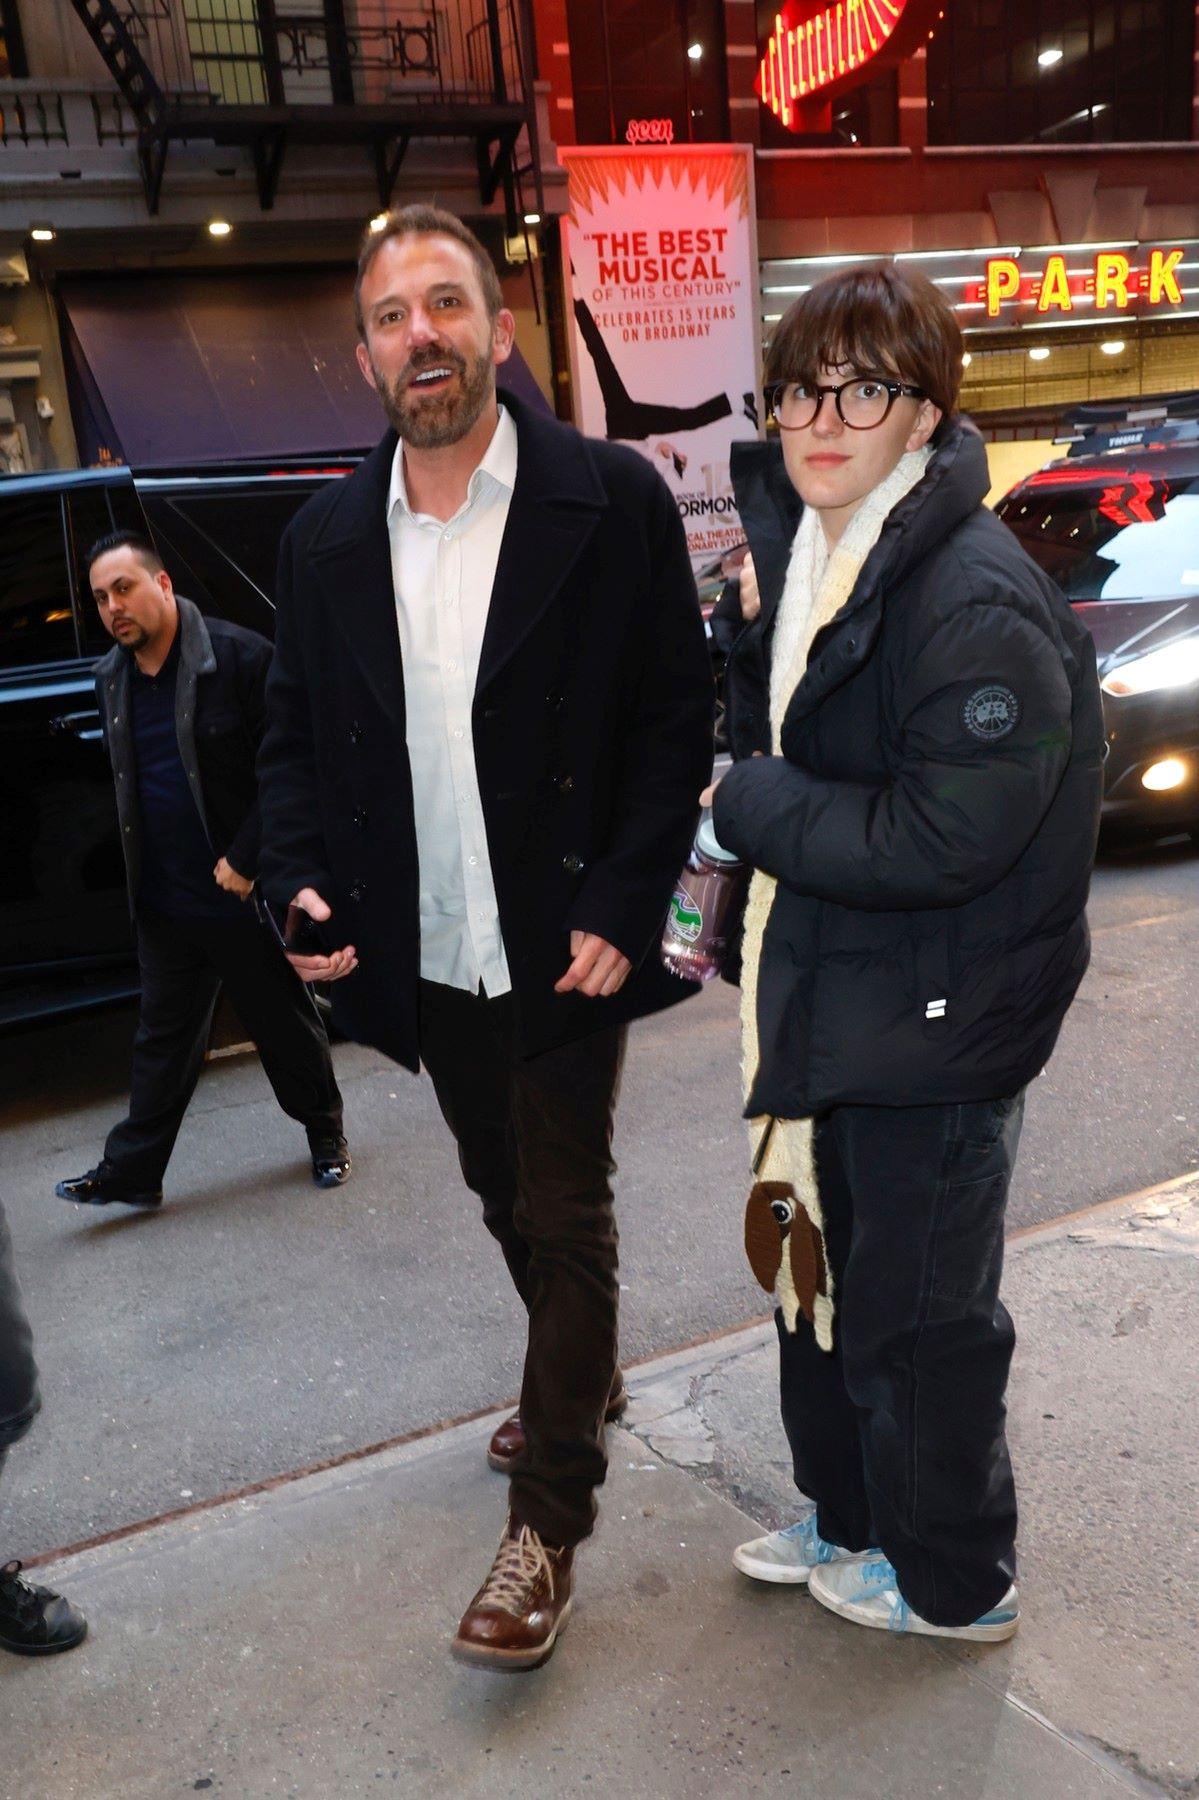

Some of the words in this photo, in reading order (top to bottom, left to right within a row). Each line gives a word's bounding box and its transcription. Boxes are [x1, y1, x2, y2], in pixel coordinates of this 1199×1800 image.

[584, 231, 648, 258] "THE
[659, 228, 728, 254] BEST
[599, 255, 726, 285] MUSICAL
[986, 248, 1185, 317] PARK
[592, 288, 613, 303] OF
[621, 286, 656, 300] THIS
[594, 308, 673, 327] CELEBRATES
[680, 307, 692, 322] 15
[698, 304, 736, 320] YEARS
[622, 327, 639, 342] ON
[645, 324, 711, 341] BROADWAY
[678, 496, 738, 518] ORMON
[687, 531, 704, 542] CAL
